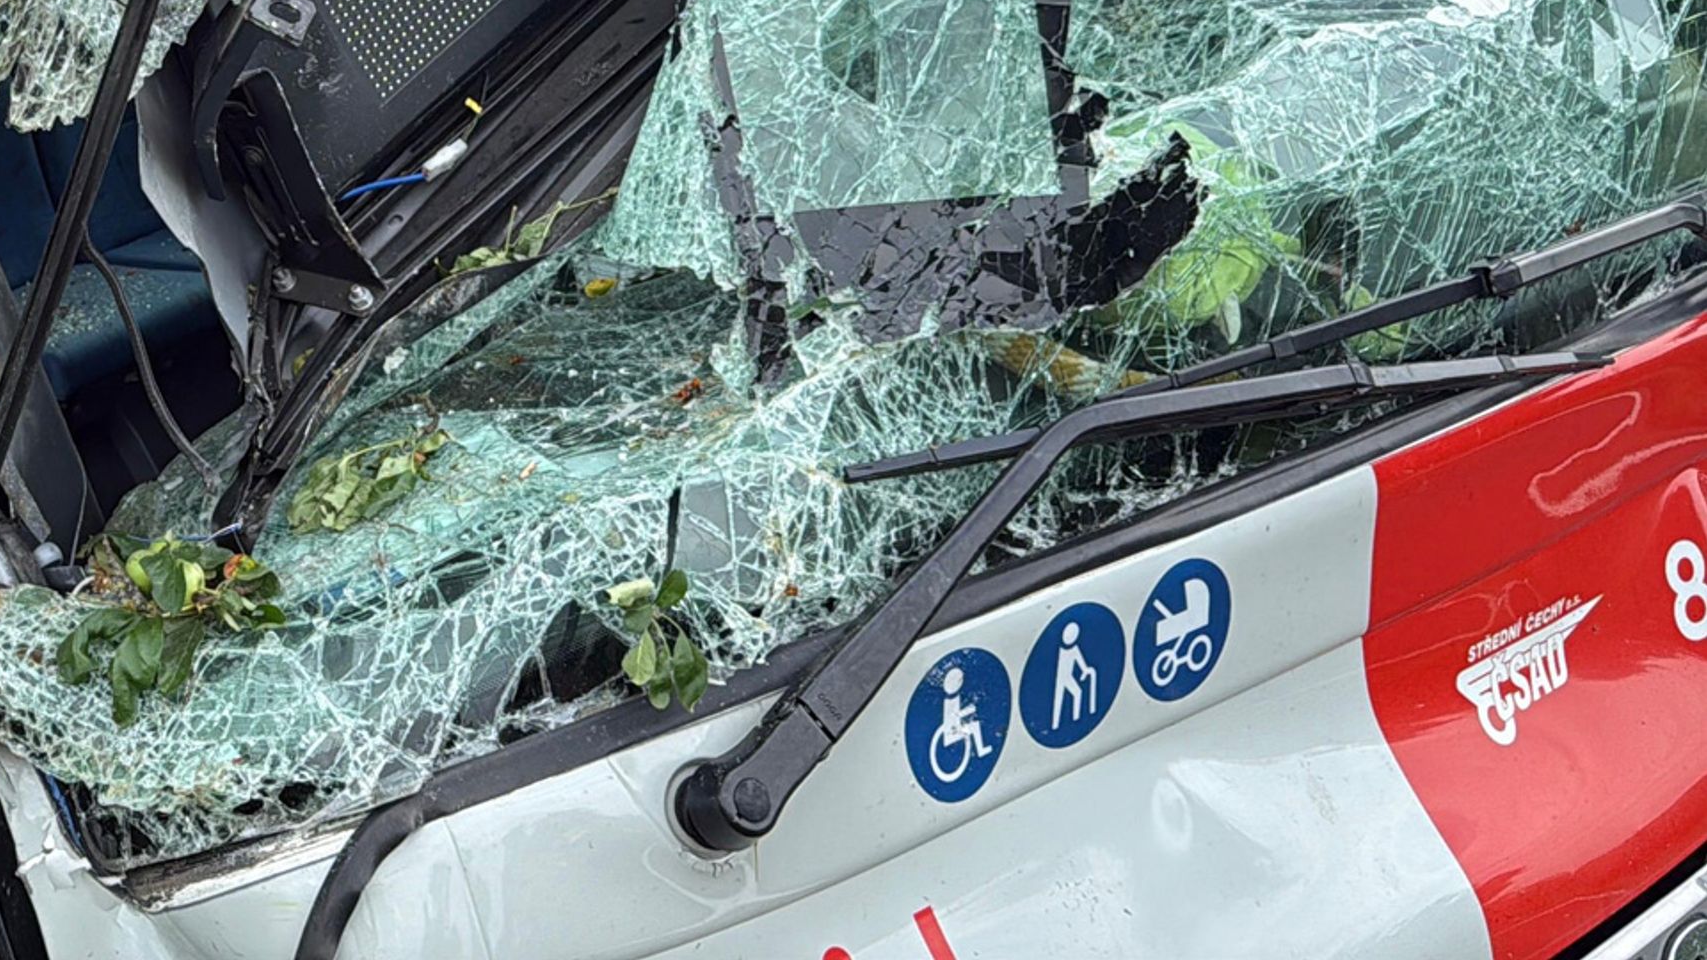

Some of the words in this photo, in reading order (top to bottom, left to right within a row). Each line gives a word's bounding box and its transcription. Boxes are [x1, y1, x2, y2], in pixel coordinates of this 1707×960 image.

[1467, 616, 1523, 663] STŘEDNÍ
[1524, 597, 1567, 633] ČECHY
[1478, 632, 1569, 746] ČSAD
